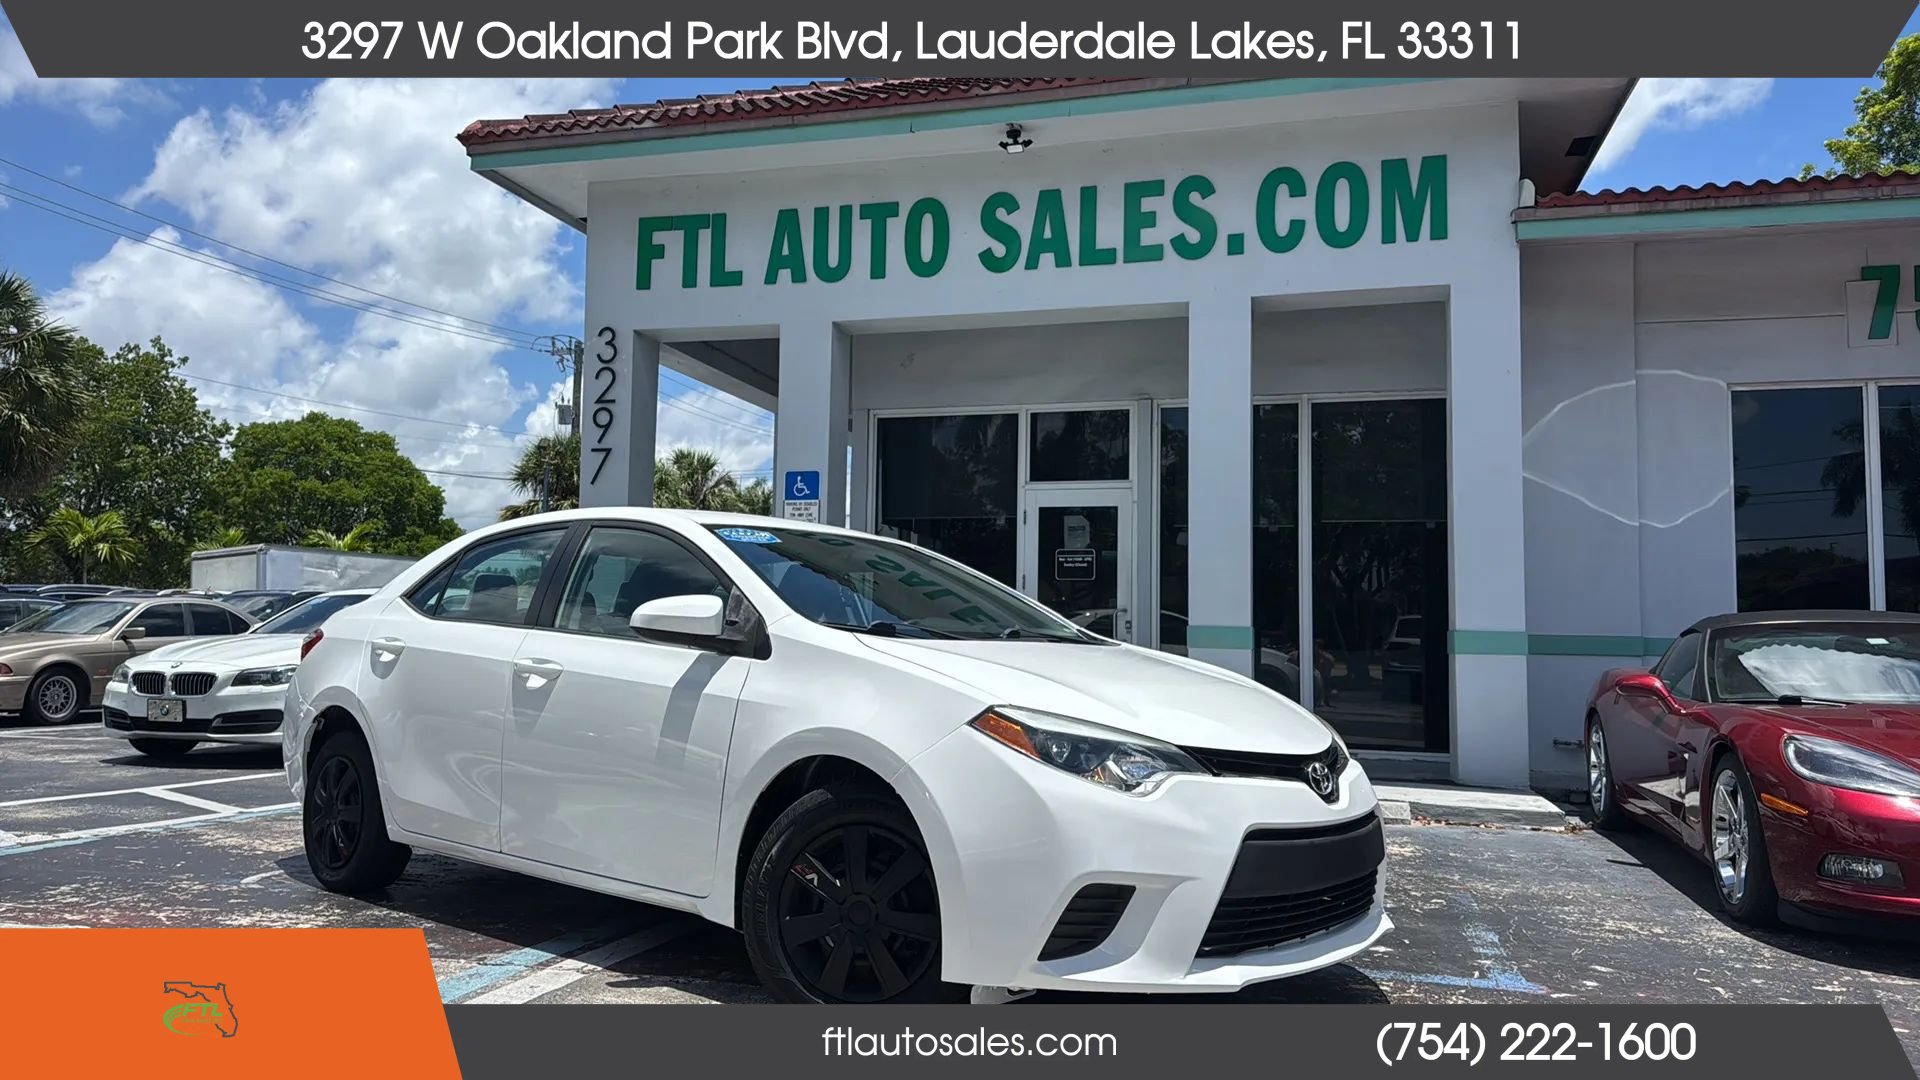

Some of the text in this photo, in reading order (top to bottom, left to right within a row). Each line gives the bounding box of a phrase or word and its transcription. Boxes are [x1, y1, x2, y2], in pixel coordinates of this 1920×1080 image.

[635, 155, 1449, 290] FTL AUTO SALES.COM
[1860, 264, 1920, 340] 7
[590, 326, 618, 486] 3297
